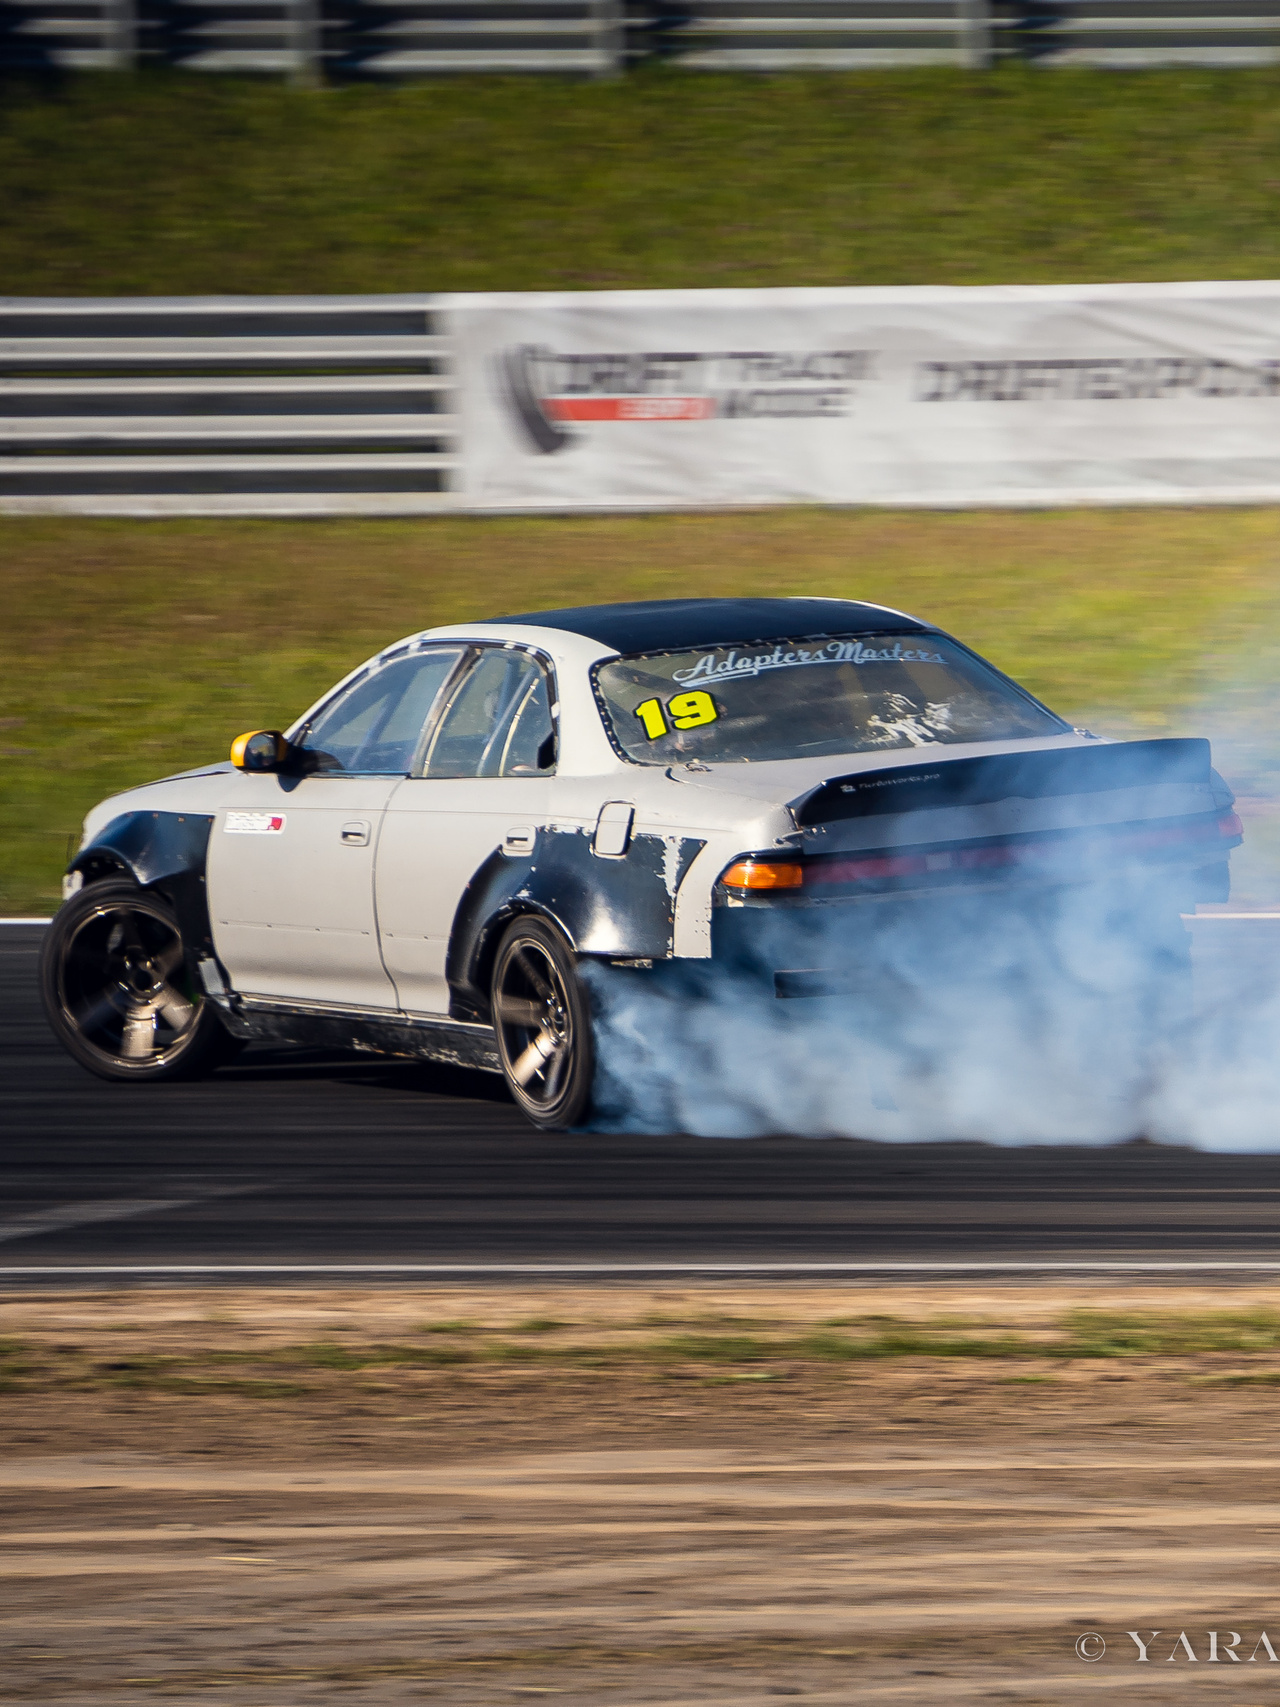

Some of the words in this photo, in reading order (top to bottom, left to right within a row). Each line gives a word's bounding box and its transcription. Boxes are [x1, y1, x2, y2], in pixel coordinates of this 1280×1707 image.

[549, 352, 712, 394] DRIFT
[672, 645, 827, 684] Adapters
[826, 641, 949, 664] Masters
[634, 689, 720, 741] 19
